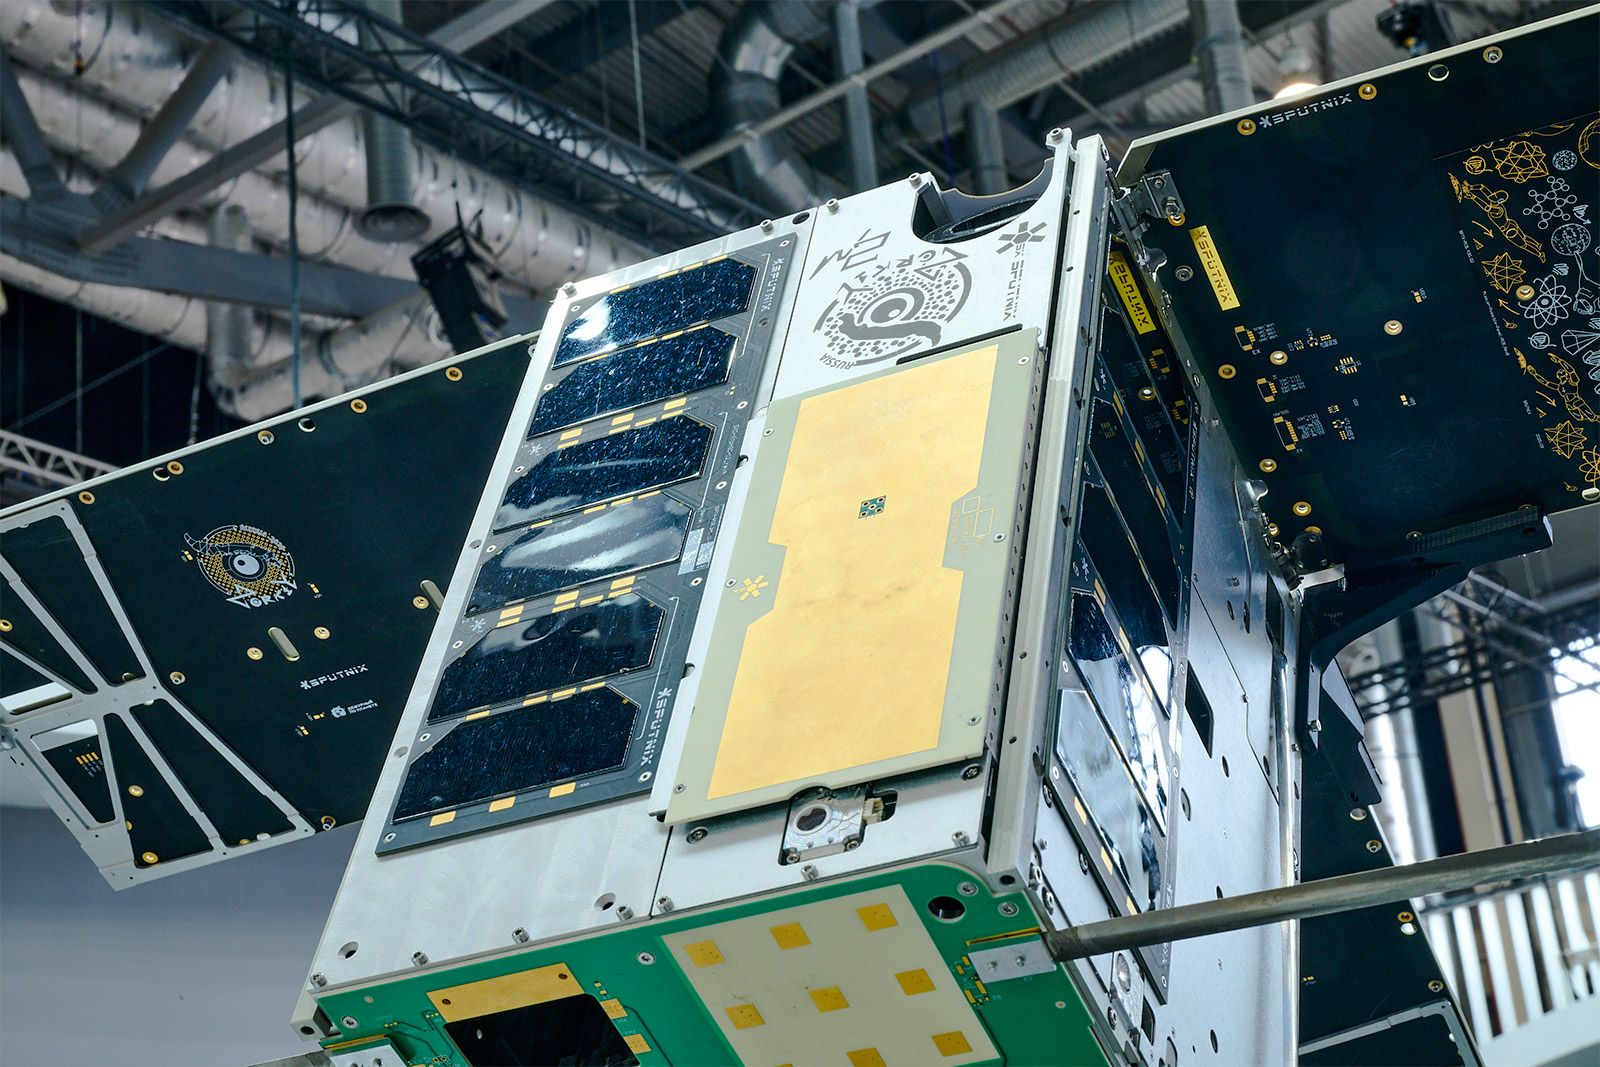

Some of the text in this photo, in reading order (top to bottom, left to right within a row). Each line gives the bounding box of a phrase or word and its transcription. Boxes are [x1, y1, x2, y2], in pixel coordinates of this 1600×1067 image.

[1272, 92, 1353, 124] SPUTNIX
[767, 265, 780, 311] SPUTNIX
[1003, 259, 1025, 321] SPUTNIX
[1198, 240, 1232, 303] SPUTNIX
[310, 664, 369, 687] SPUTNIX
[642, 700, 668, 764] SPUTNIX
